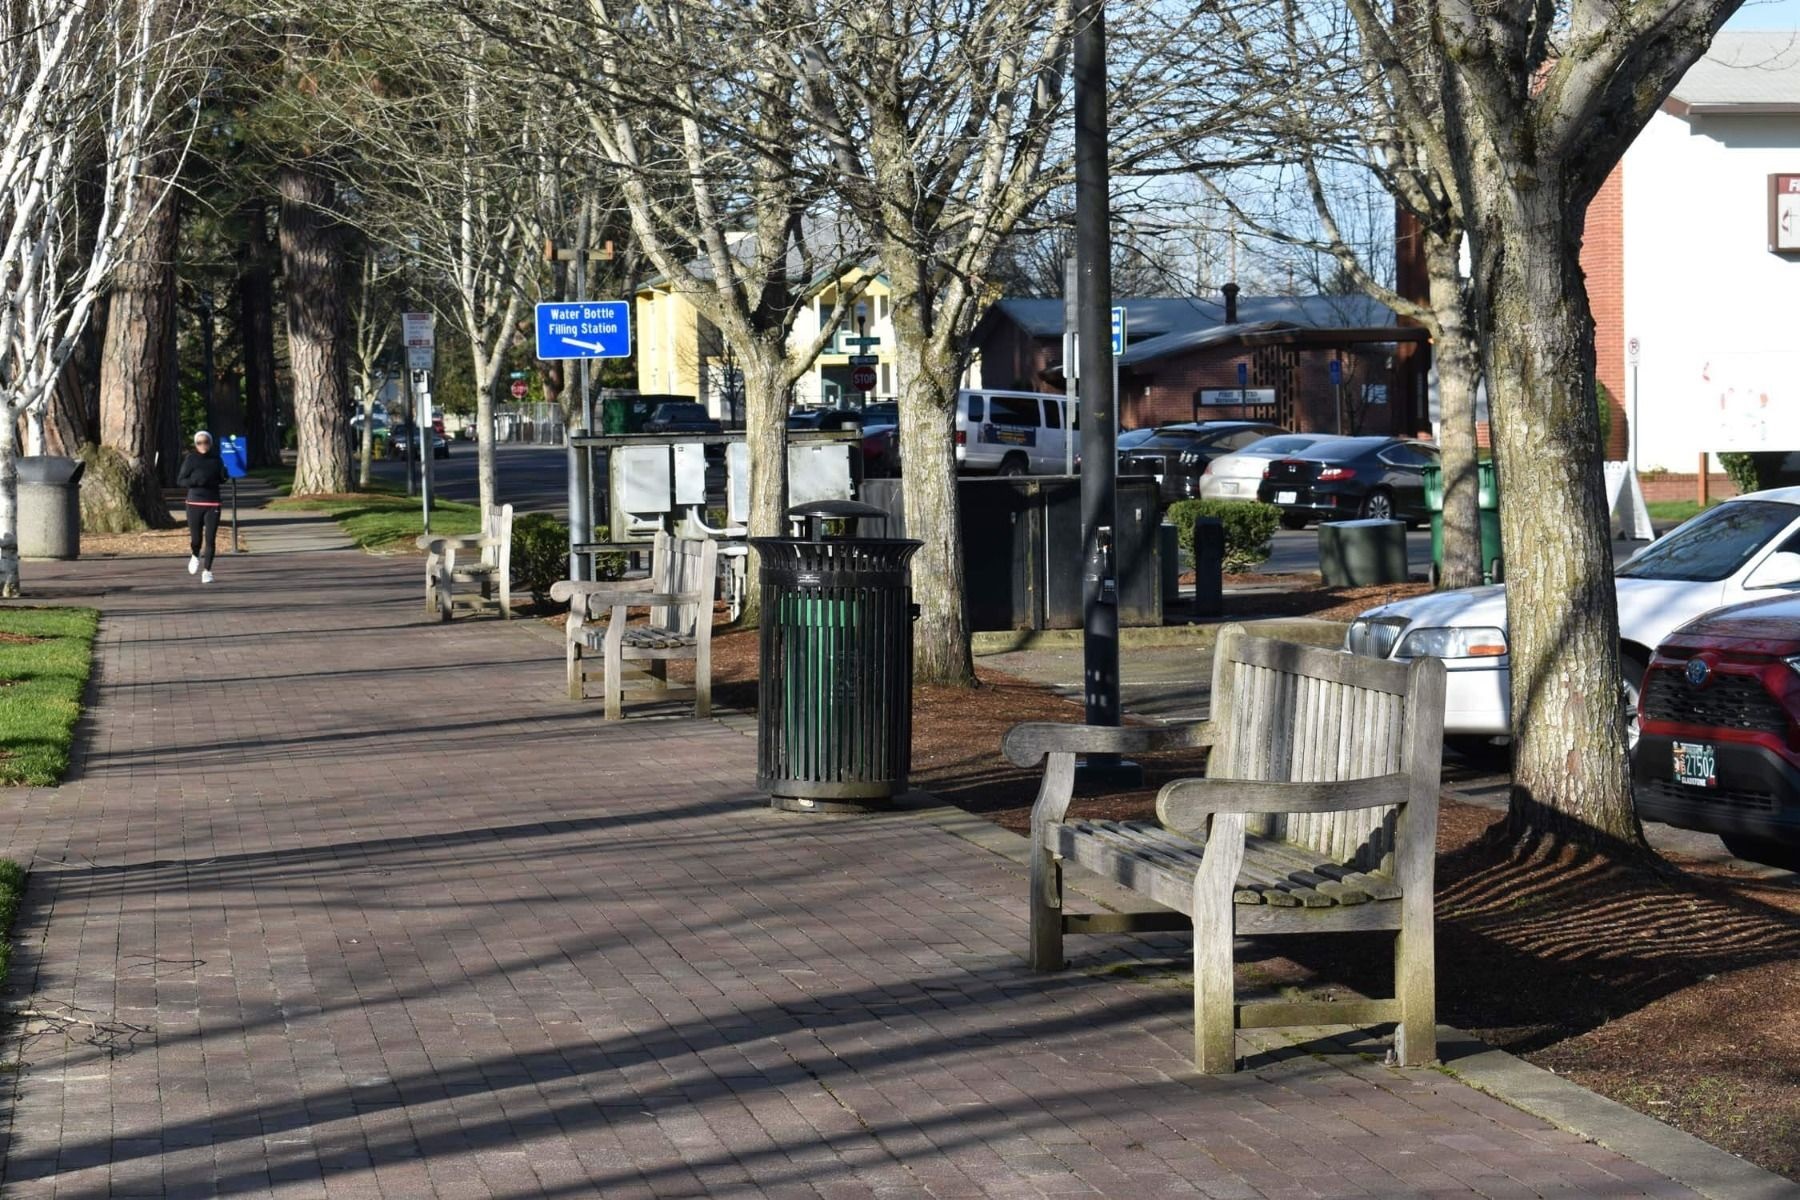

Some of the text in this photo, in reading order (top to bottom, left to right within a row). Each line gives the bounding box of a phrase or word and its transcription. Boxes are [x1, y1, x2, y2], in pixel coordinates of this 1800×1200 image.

[550, 308, 614, 320] Water Bottle
[549, 323, 617, 337] Filling Station
[854, 373, 876, 384] STOP
[1686, 754, 1716, 778] 27502
